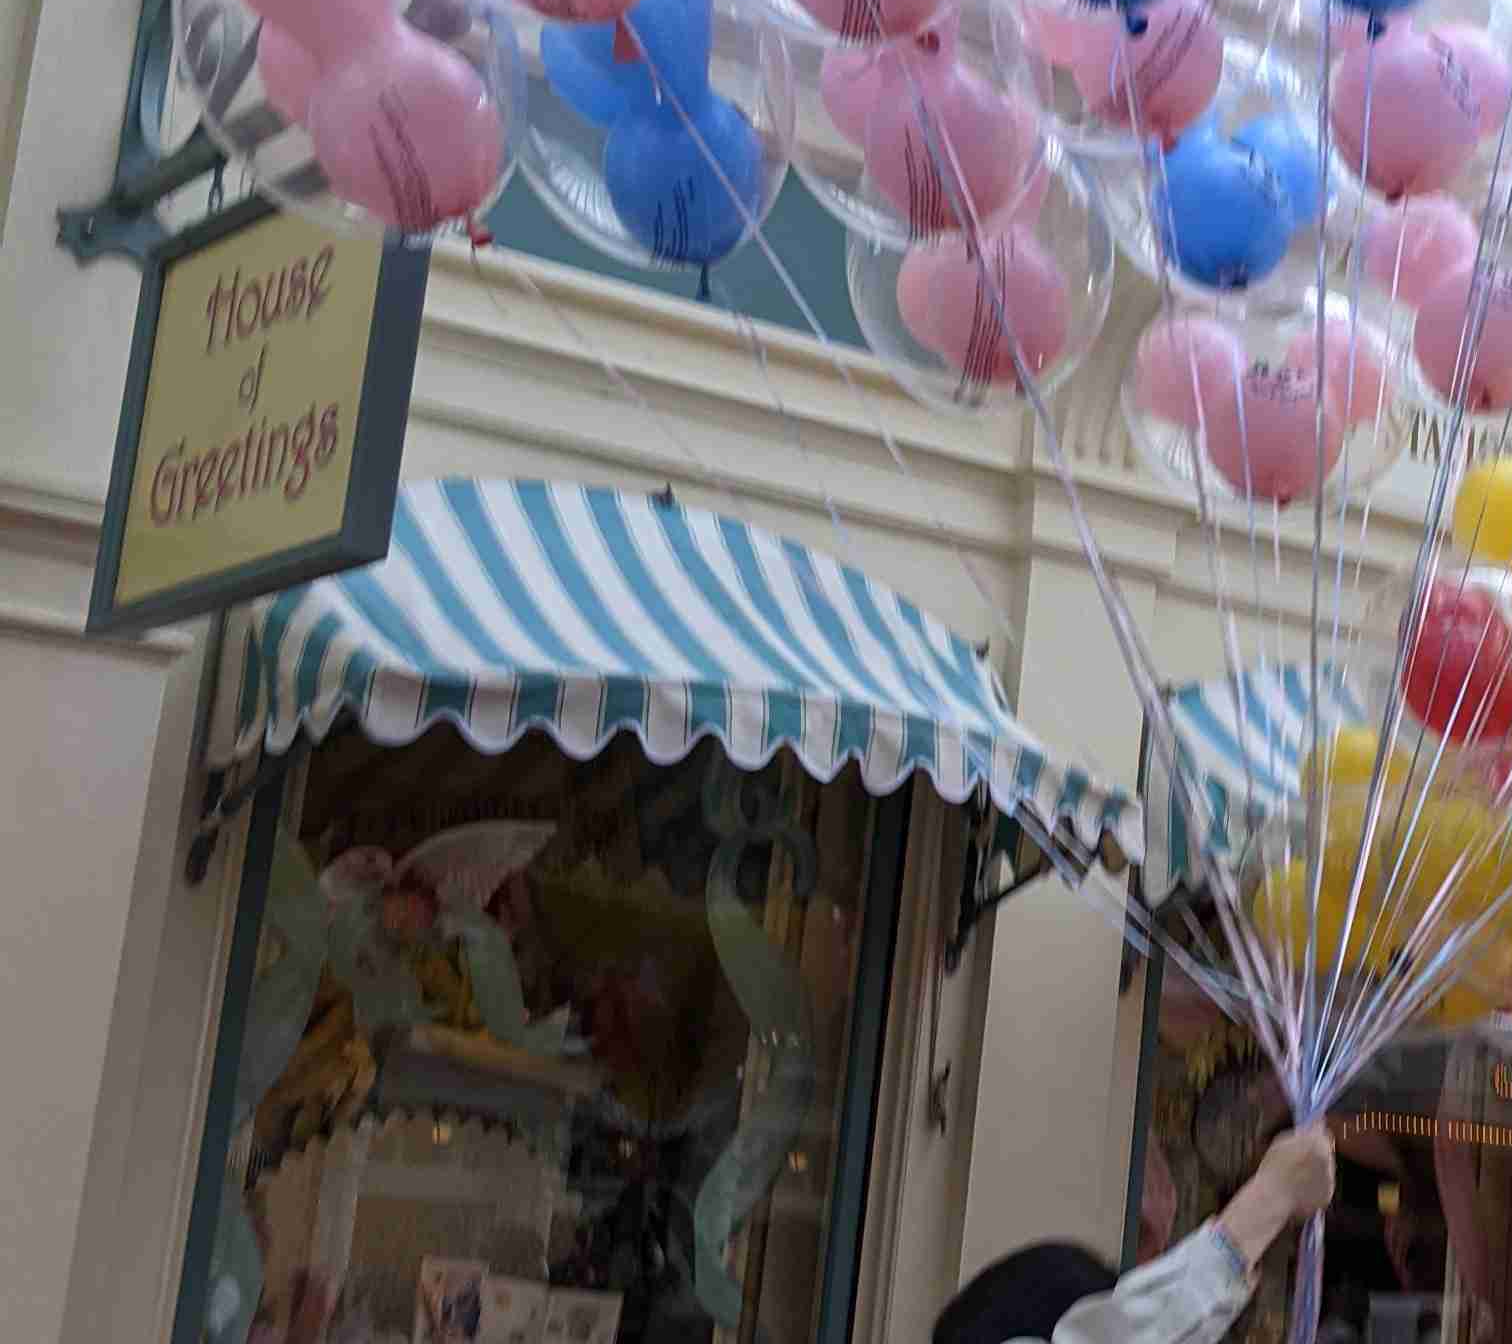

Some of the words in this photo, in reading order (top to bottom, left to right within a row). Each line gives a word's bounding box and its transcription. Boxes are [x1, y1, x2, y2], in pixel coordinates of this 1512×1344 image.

[207, 246, 334, 353] House
[238, 346, 265, 413] of
[150, 402, 340, 528] Greetings
